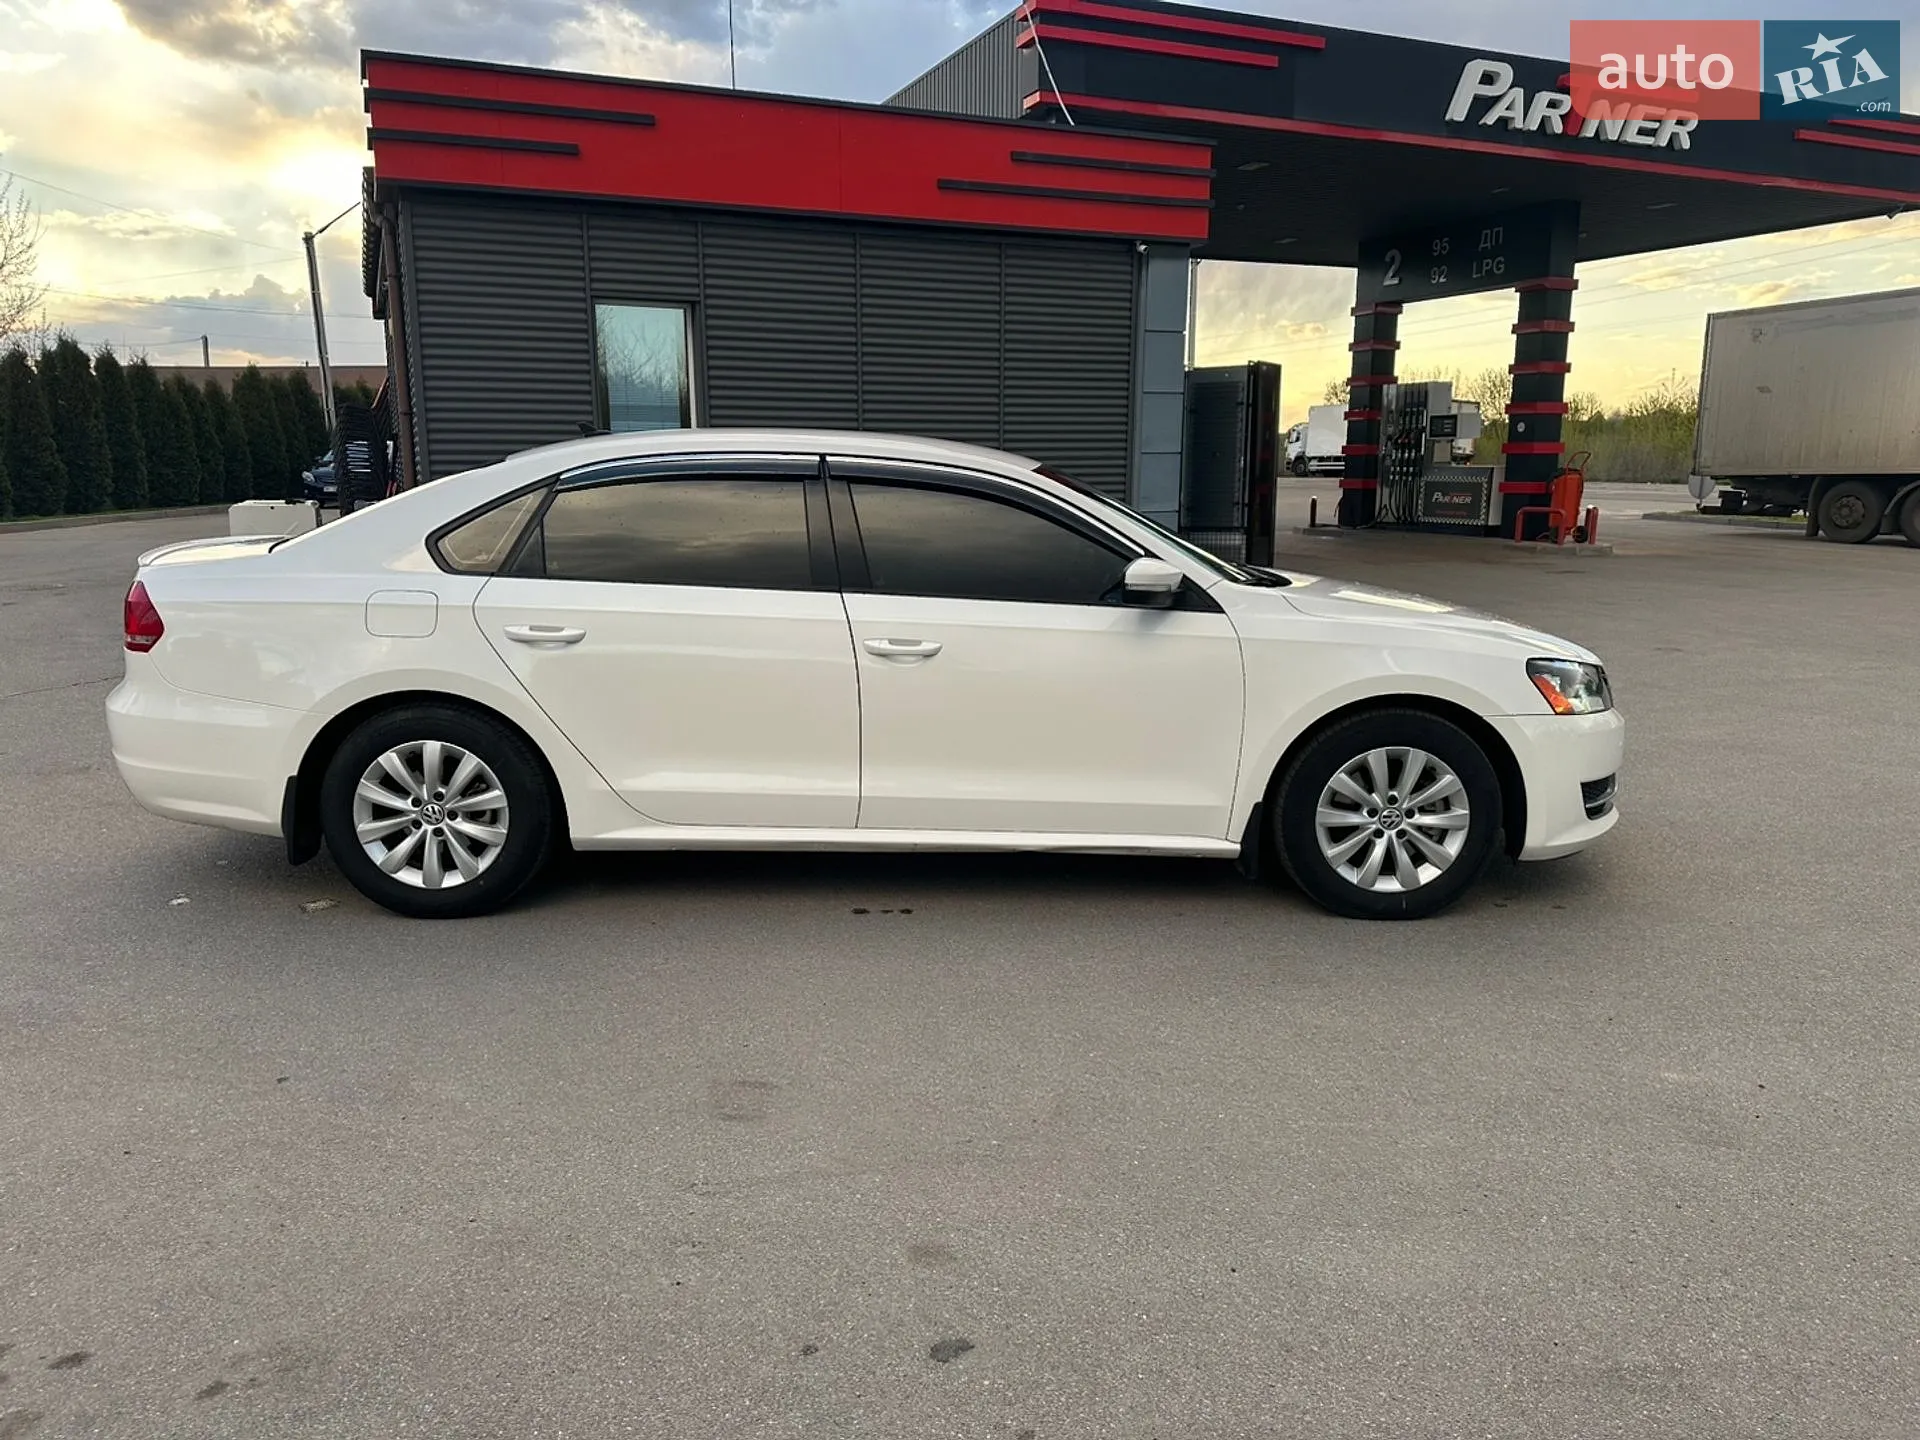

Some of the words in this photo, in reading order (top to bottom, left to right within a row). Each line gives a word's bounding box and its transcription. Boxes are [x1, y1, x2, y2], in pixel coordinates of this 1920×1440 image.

[1432, 237, 1449, 256] 95
[1478, 227, 1504, 252] ДП
[1383, 249, 1402, 286] 2
[1430, 265, 1448, 284] 92
[1472, 256, 1505, 279] LPG
